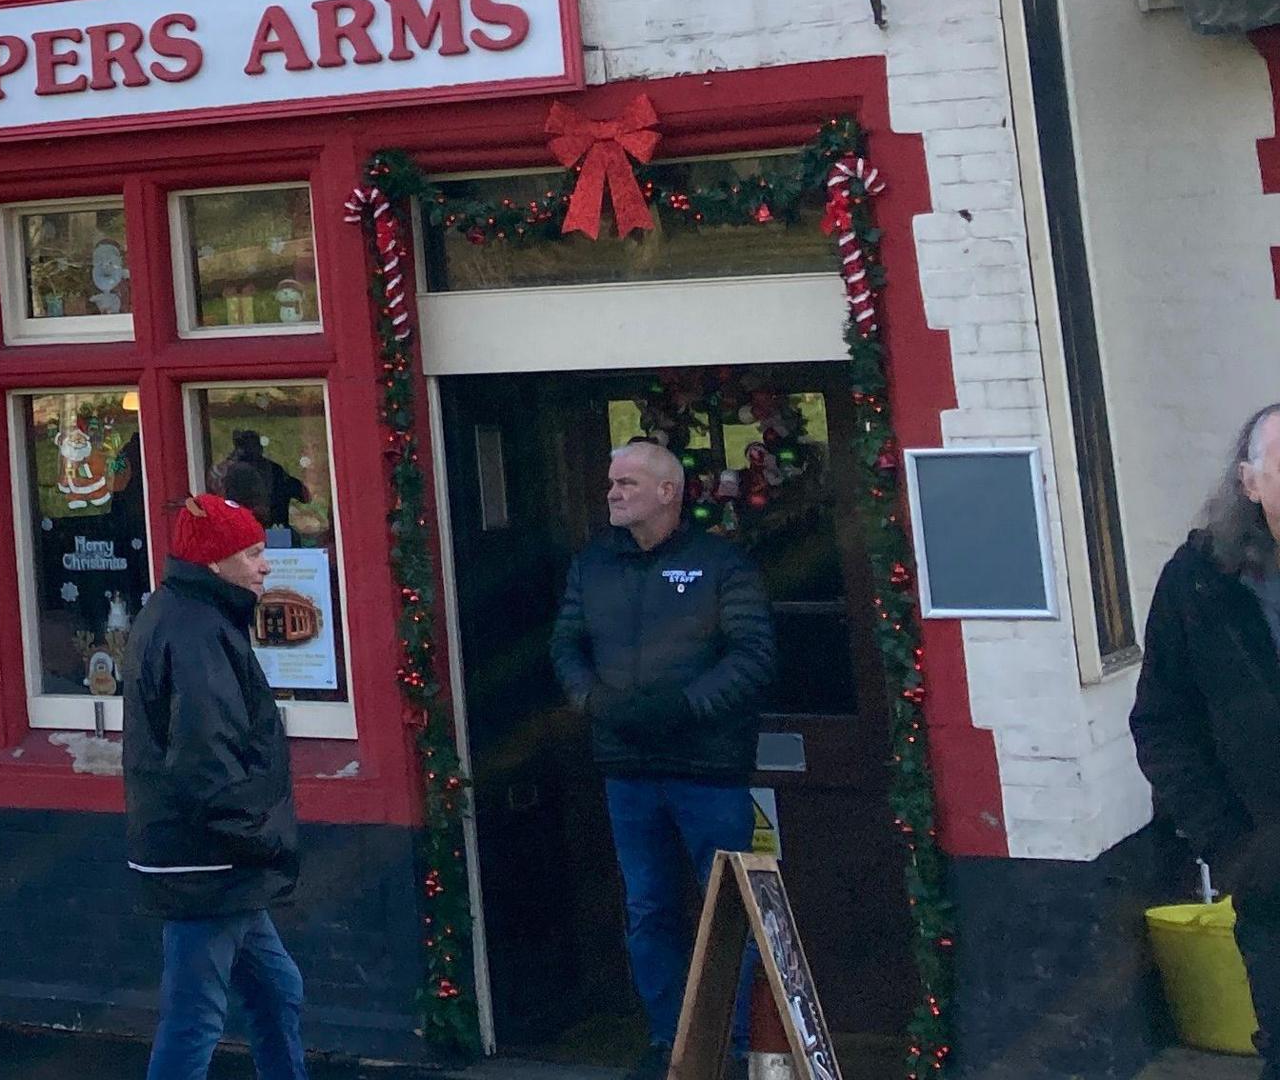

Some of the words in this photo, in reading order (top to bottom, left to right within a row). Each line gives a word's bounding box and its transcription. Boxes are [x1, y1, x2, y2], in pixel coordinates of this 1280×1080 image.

[74, 535, 114, 558] Merry
[62, 552, 128, 571] Christmas
[668, 575, 695, 583] STAFF
